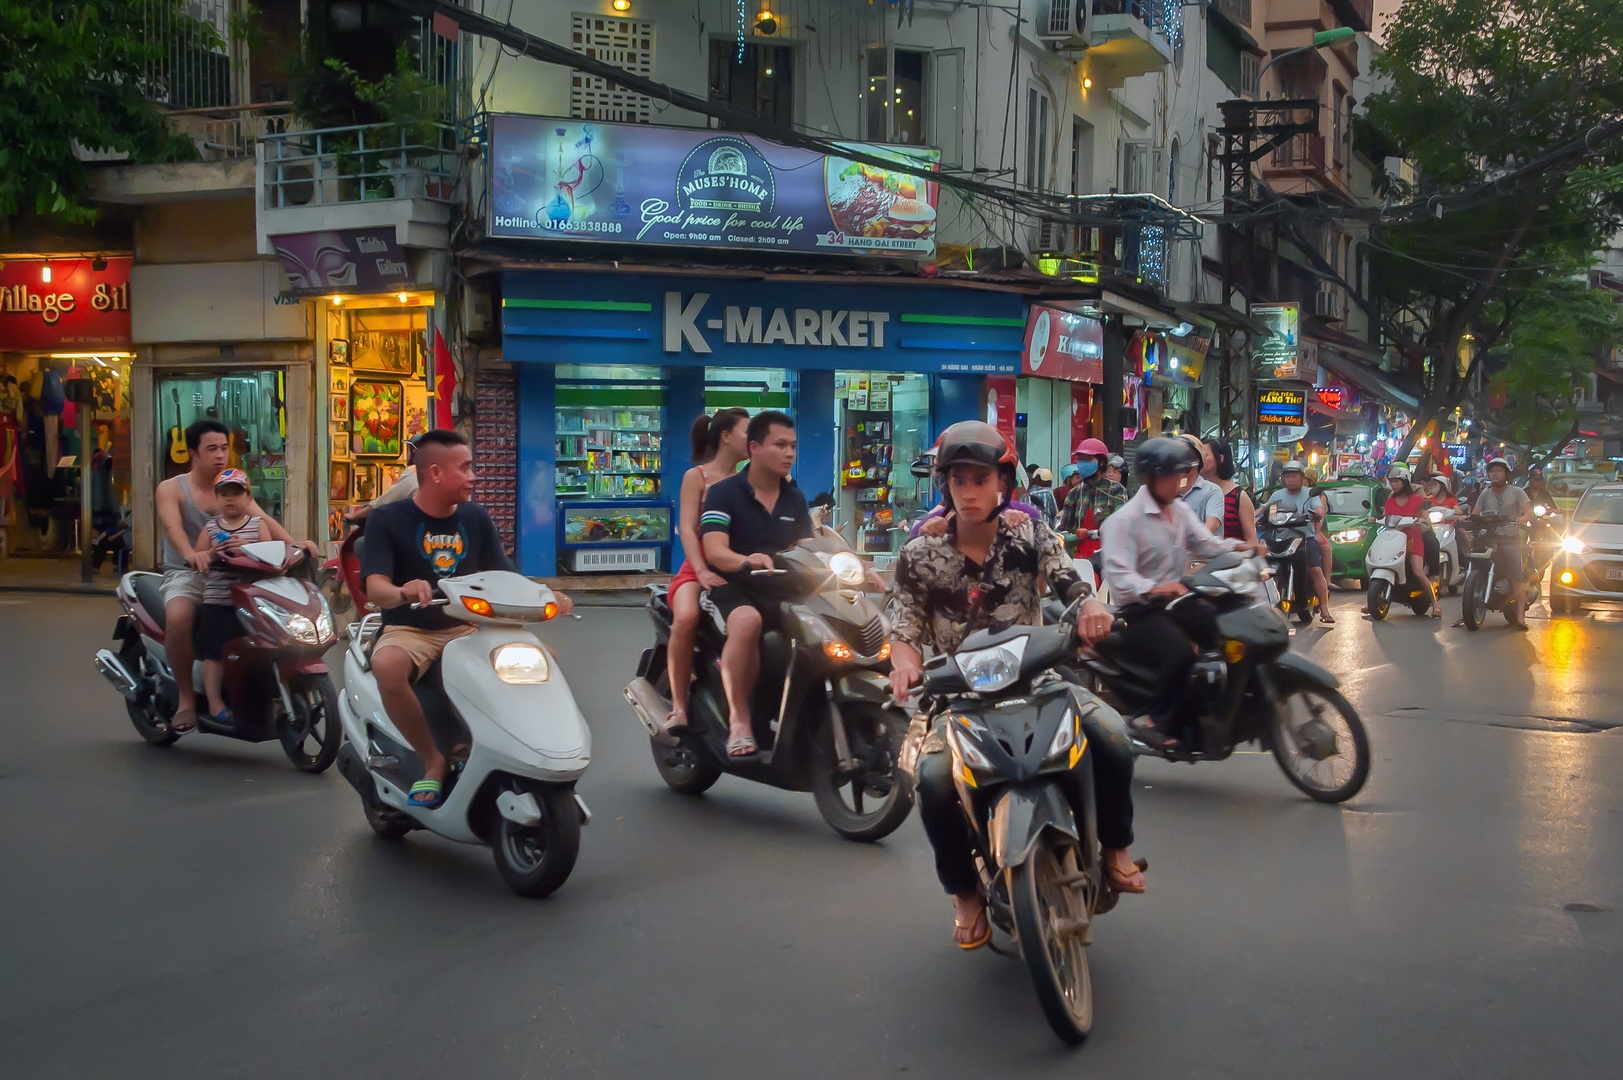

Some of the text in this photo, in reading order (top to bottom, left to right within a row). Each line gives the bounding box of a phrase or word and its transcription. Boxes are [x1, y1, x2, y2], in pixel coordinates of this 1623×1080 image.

[682, 176, 768, 200] MUSES'HOME
[690, 200, 708, 208] FOOD
[495, 216, 622, 234] Hotline: 01663838888
[636, 198, 804, 240] Good price for cool life
[663, 231, 722, 242] Open: 9h00 am
[727, 234, 756, 244] Closed:
[757, 236, 776, 245] 2h00
[827, 232, 917, 249] 34 HANG GAI STREET
[375, 258, 409, 279] Gallery
[663, 291, 889, 353] K-MARKET
